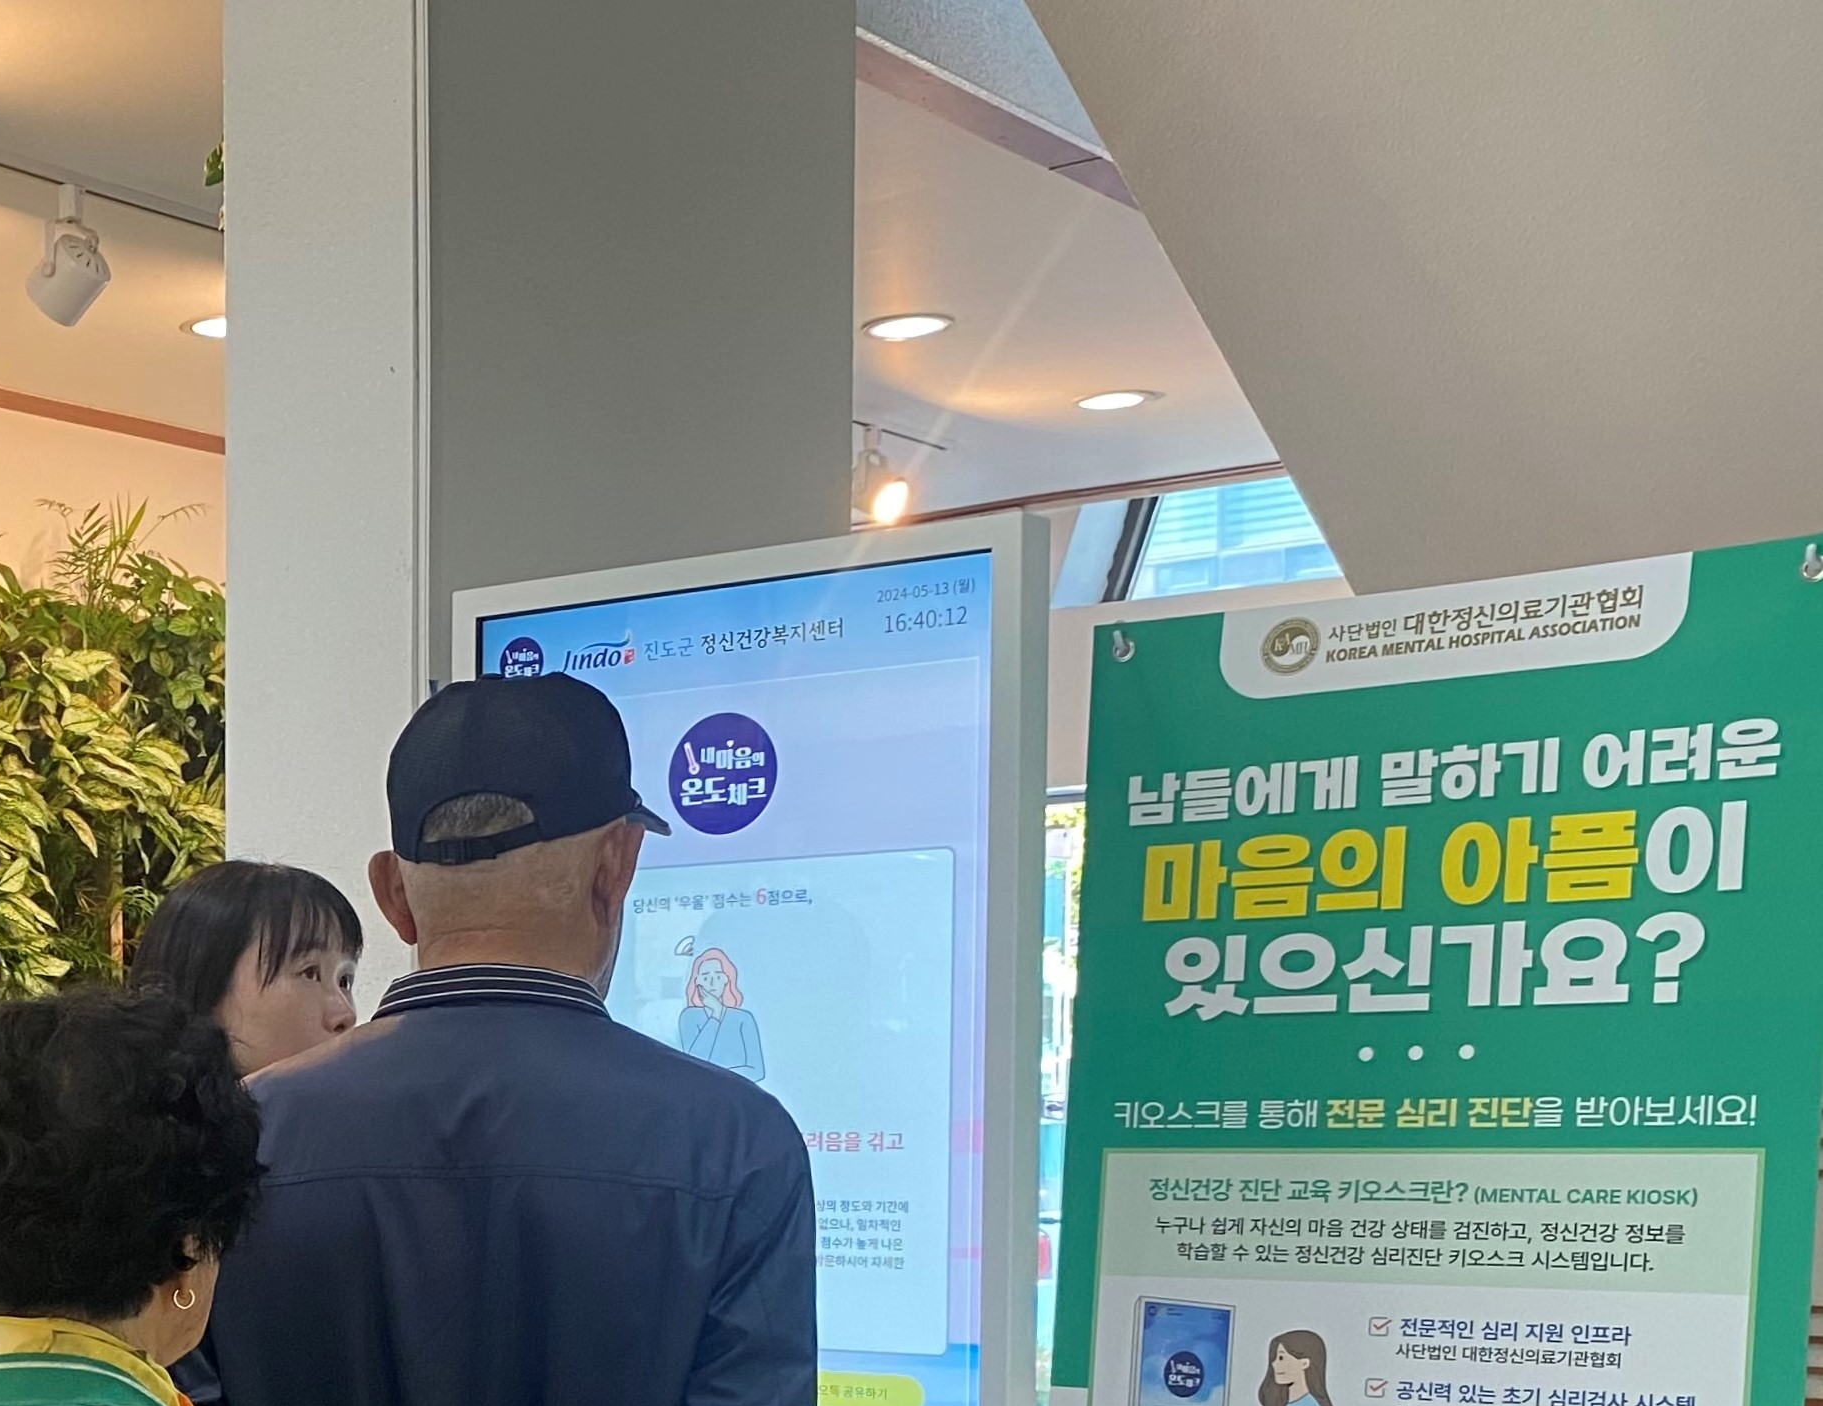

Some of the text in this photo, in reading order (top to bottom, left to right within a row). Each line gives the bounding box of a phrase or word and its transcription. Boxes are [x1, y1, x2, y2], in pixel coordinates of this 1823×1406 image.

[877, 578, 975, 602] 2024-05-13 (월)
[885, 606, 967, 633] 16:40:12
[1329, 585, 1643, 642] 사단법인 대한정신의료기관협회
[563, 648, 621, 673] Jindo
[645, 638, 694, 661] 진도군
[700, 617, 844, 655] 정신건강복지센터
[1326, 613, 1640, 662] KOREA MENTAL HOSPITAL ASSOCIATION
[701, 740, 764, 769] 내마음의
[1129, 719, 1781, 828] 남들에게 말하기 어려운
[680, 777, 766, 806] 온도체크
[1144, 800, 1749, 923] 마음의 아픔이
[633, 897, 670, 913] 당신의
[713, 892, 751, 909] 점수는
[756, 888, 812, 905] 6점으로,
[1162, 912, 1706, 1023] 있으신가요?
[1114, 1095, 1756, 1128] 키오스크를 통해 전문 심리 진단을 받아보세요!
[1149, 1178, 1698, 1207] 정신건강 진단 교육 키오스크란? (MENTAL CARE KIOSK)
[1155, 1217, 1685, 1244] 누구나 쉽게 자신의 마음 건강 상태를 검진하고, 정신건강 정보를
[1177, 1242, 1653, 1272] 학습할 수 있는 정신건강 심리진단 키오스크 시스템입니다.
[1400, 1318, 1631, 1346] 전문적인 심리 지원 인프라
[1396, 1343, 1621, 1368] 사단법인 대한정신의료기관협회
[844, 1386, 888, 1400] 공유하기
[1396, 1382, 1451, 1402] 공신력
[1459, 1385, 1496, 1404] 있는
[1502, 1383, 1540, 1406] 초기
